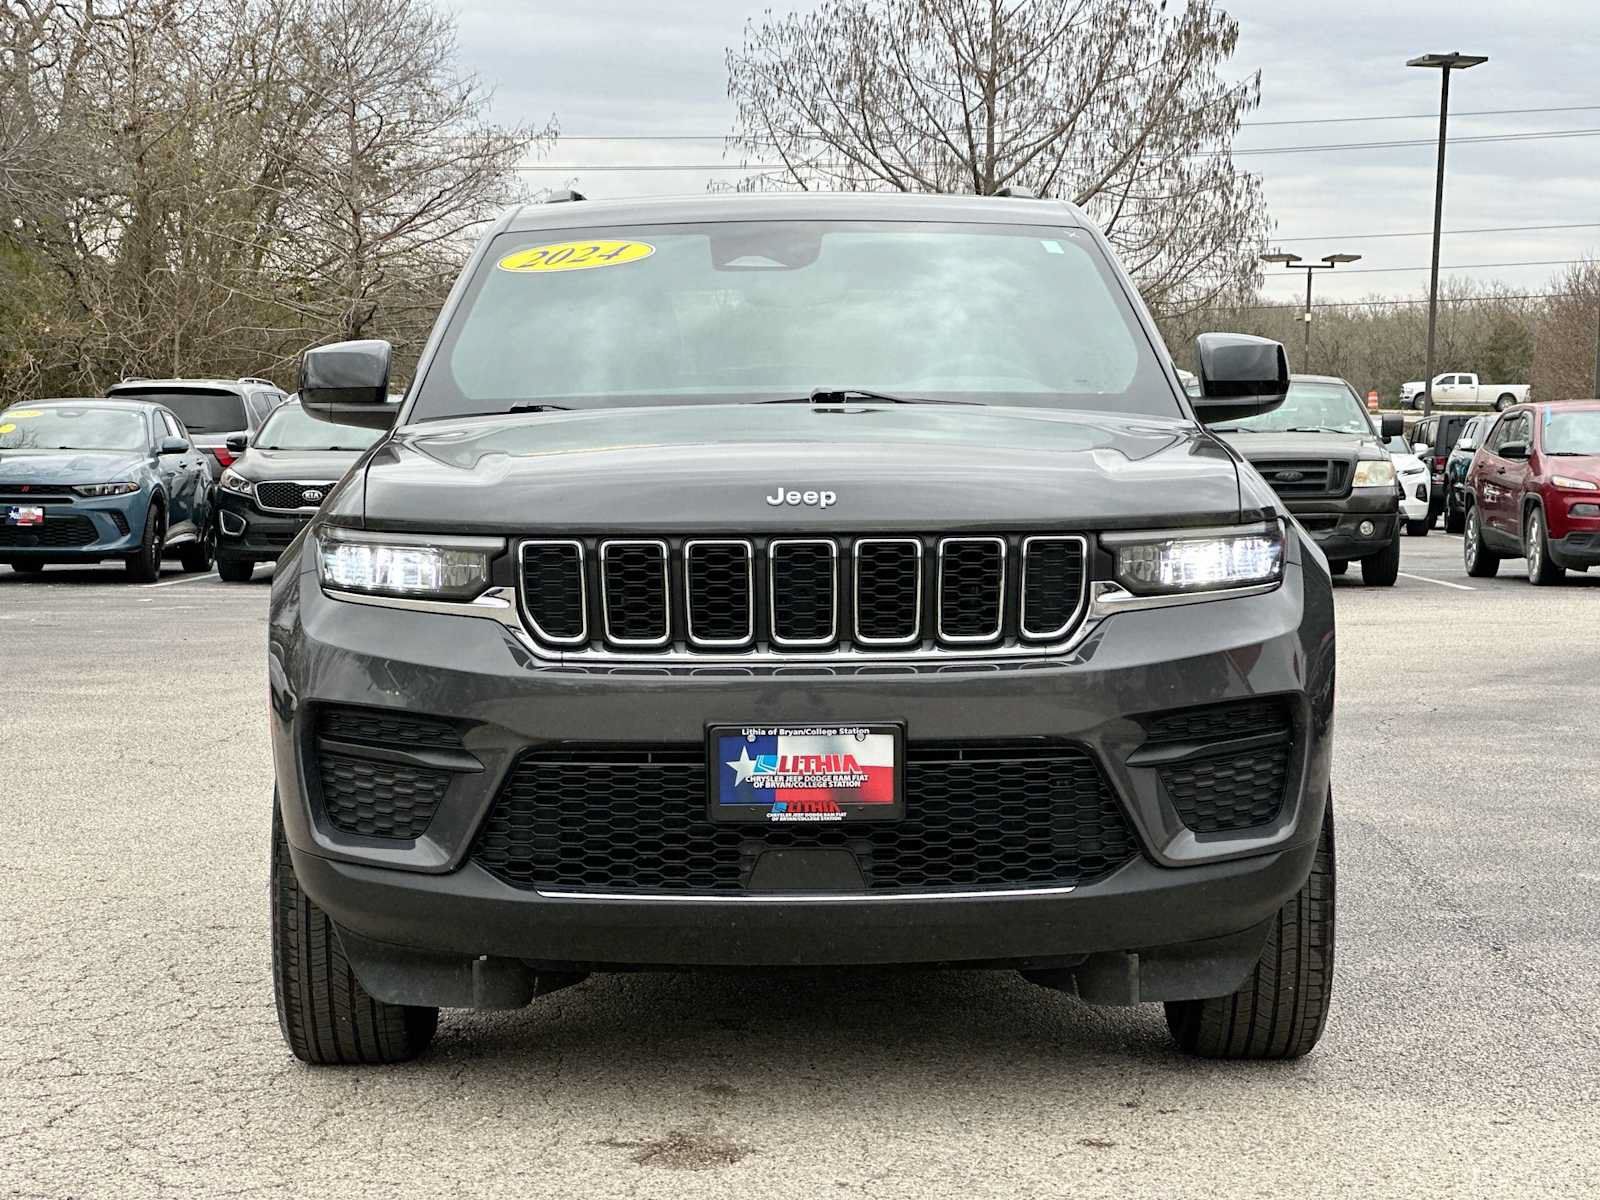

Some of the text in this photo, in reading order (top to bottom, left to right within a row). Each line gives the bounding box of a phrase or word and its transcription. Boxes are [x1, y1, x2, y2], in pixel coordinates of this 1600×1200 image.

[516, 244, 632, 269] 2024
[766, 487, 837, 508] Jeep
[741, 728, 766, 736] Lithia
[779, 728, 837, 737] Bryan/College
[839, 727, 870, 735] Station
[778, 754, 863, 774] LITHIA
[745, 775, 785, 783] CHRYSLER
[828, 780, 861, 788] STATION
